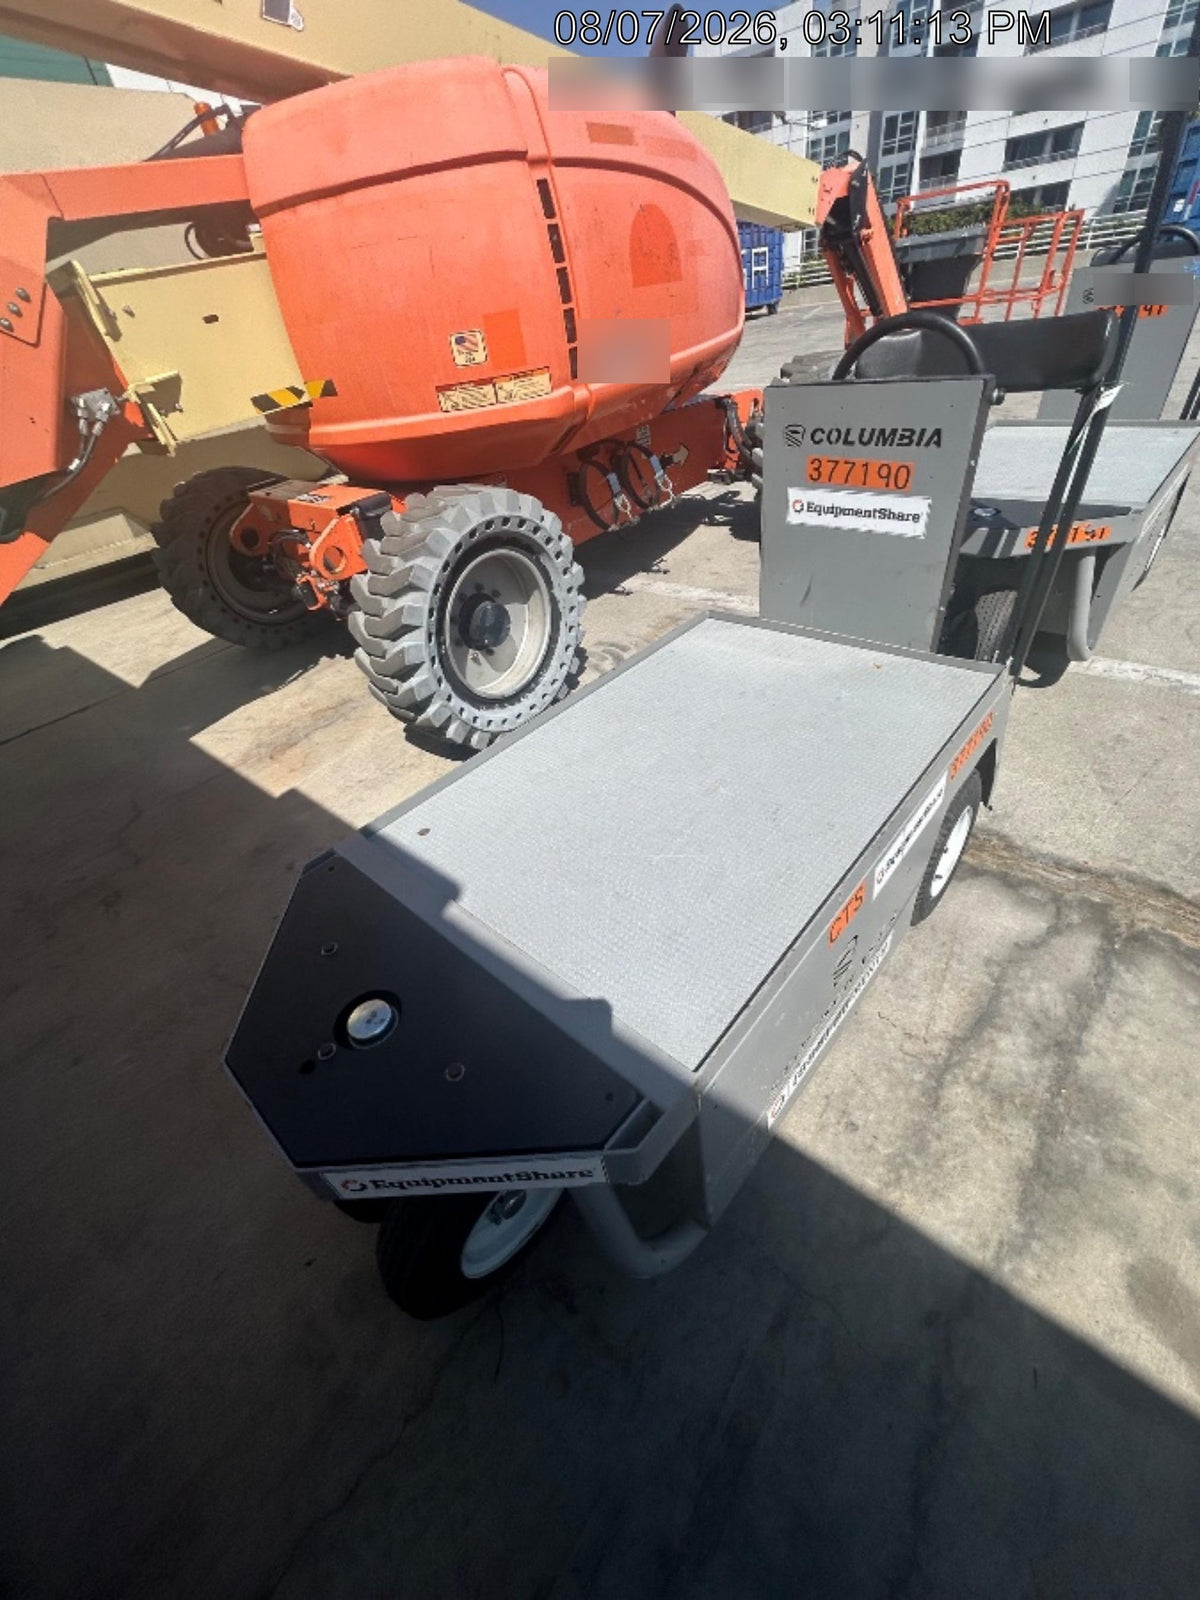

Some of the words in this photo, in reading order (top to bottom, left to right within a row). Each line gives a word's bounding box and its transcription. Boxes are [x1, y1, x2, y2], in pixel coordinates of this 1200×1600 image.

[810, 427, 943, 448] COLUMBIA
[808, 457, 912, 490] 377190
[806, 501, 921, 523] EquipmentShare
[828, 885, 864, 943] CTS
[369, 1167, 595, 1192] EquipmentShare
